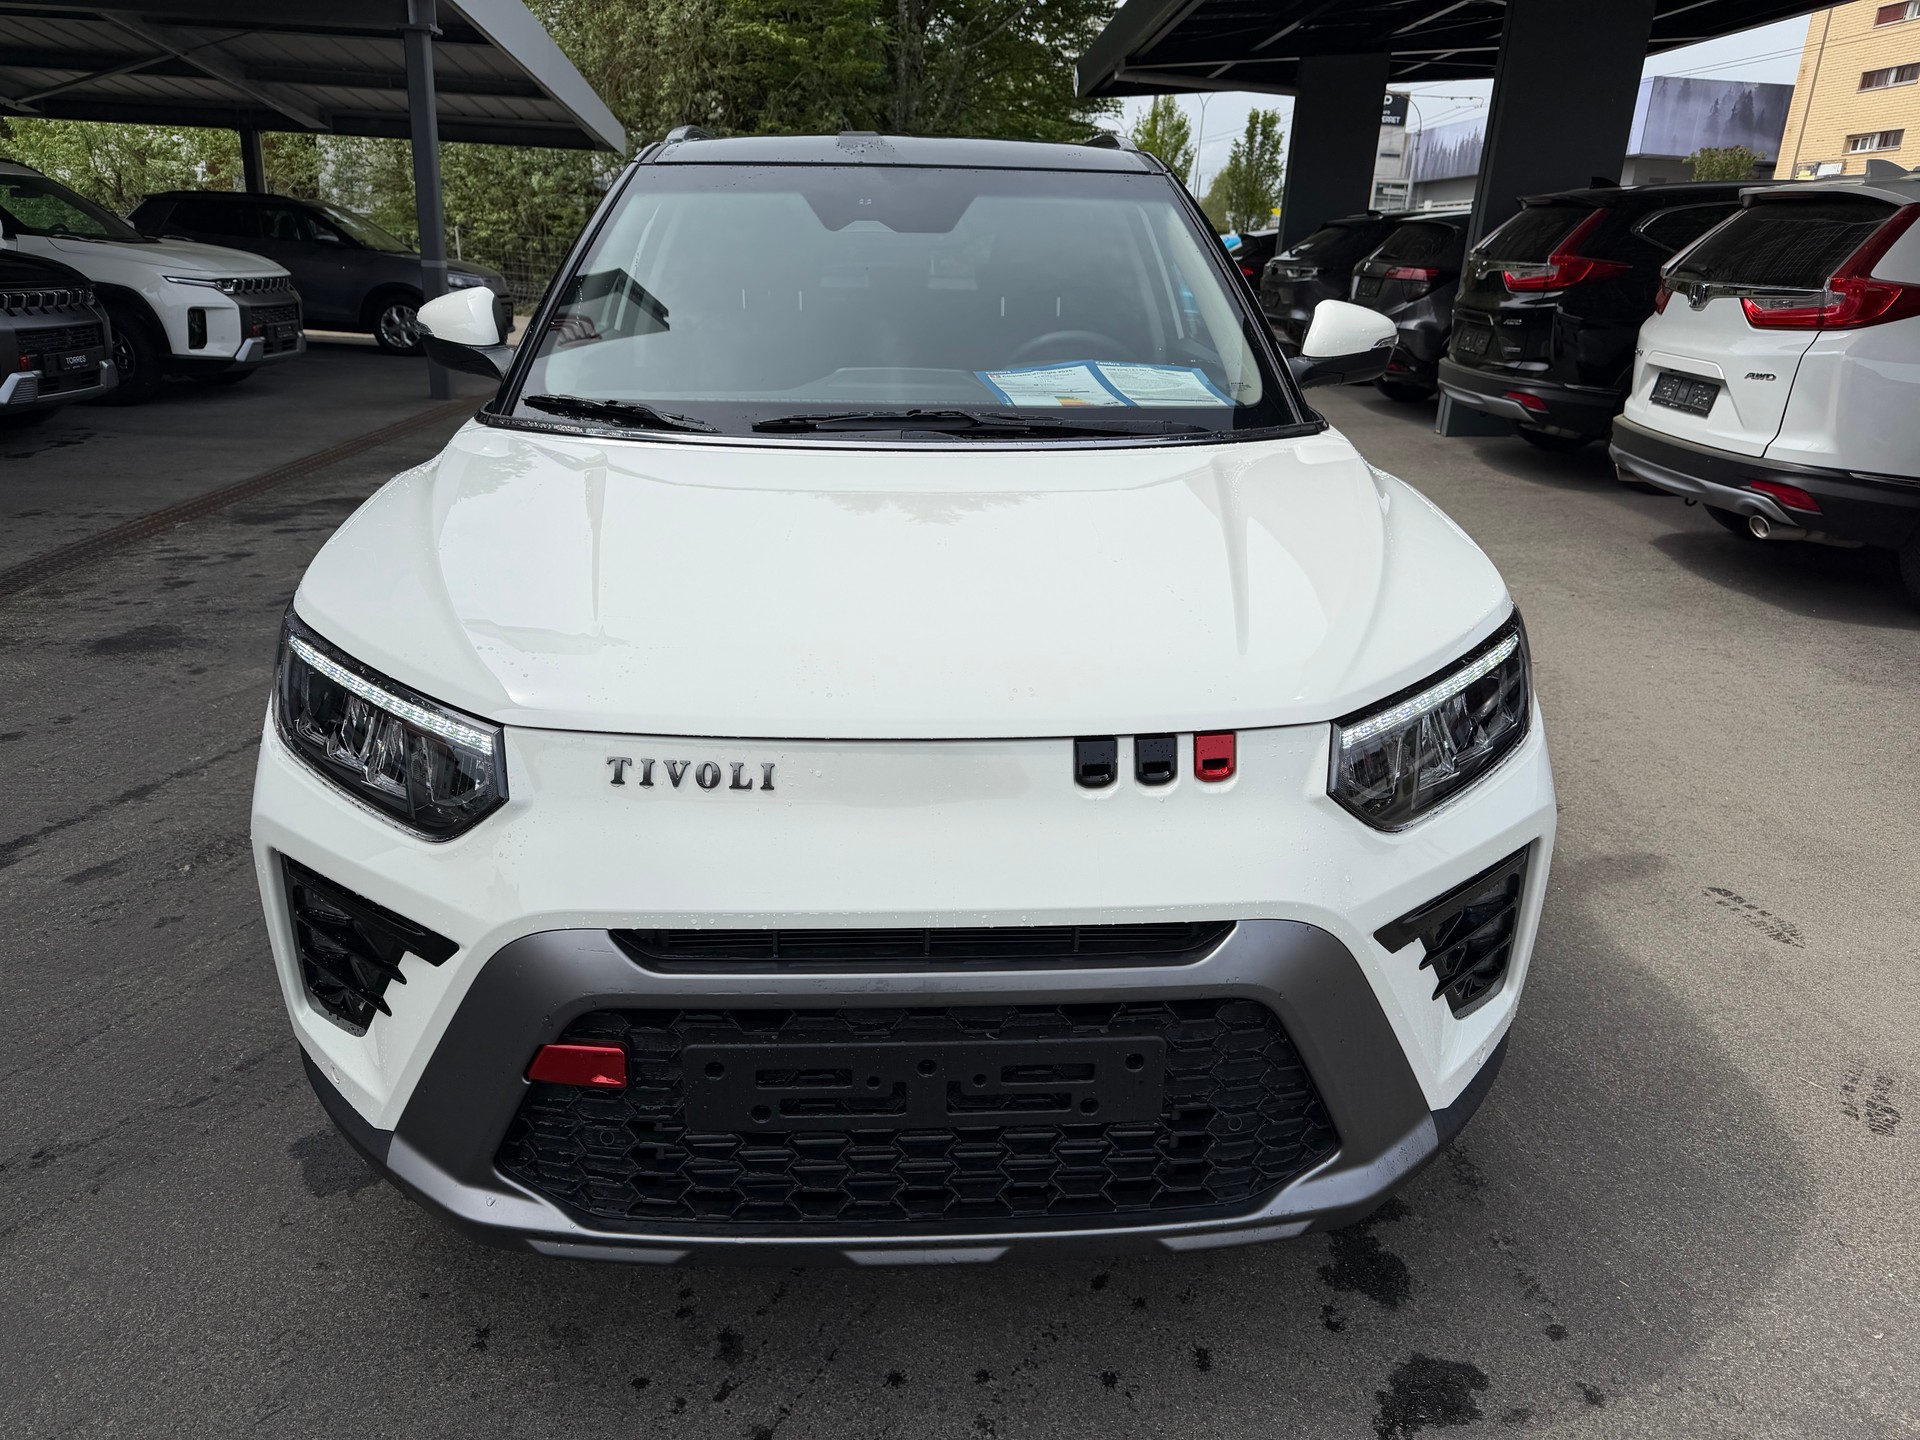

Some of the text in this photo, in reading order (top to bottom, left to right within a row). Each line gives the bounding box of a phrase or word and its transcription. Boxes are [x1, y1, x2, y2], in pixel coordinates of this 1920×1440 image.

[65, 354, 87, 364] TORRES
[1743, 372, 1777, 381] AWD
[606, 756, 776, 791] TIVOLI
